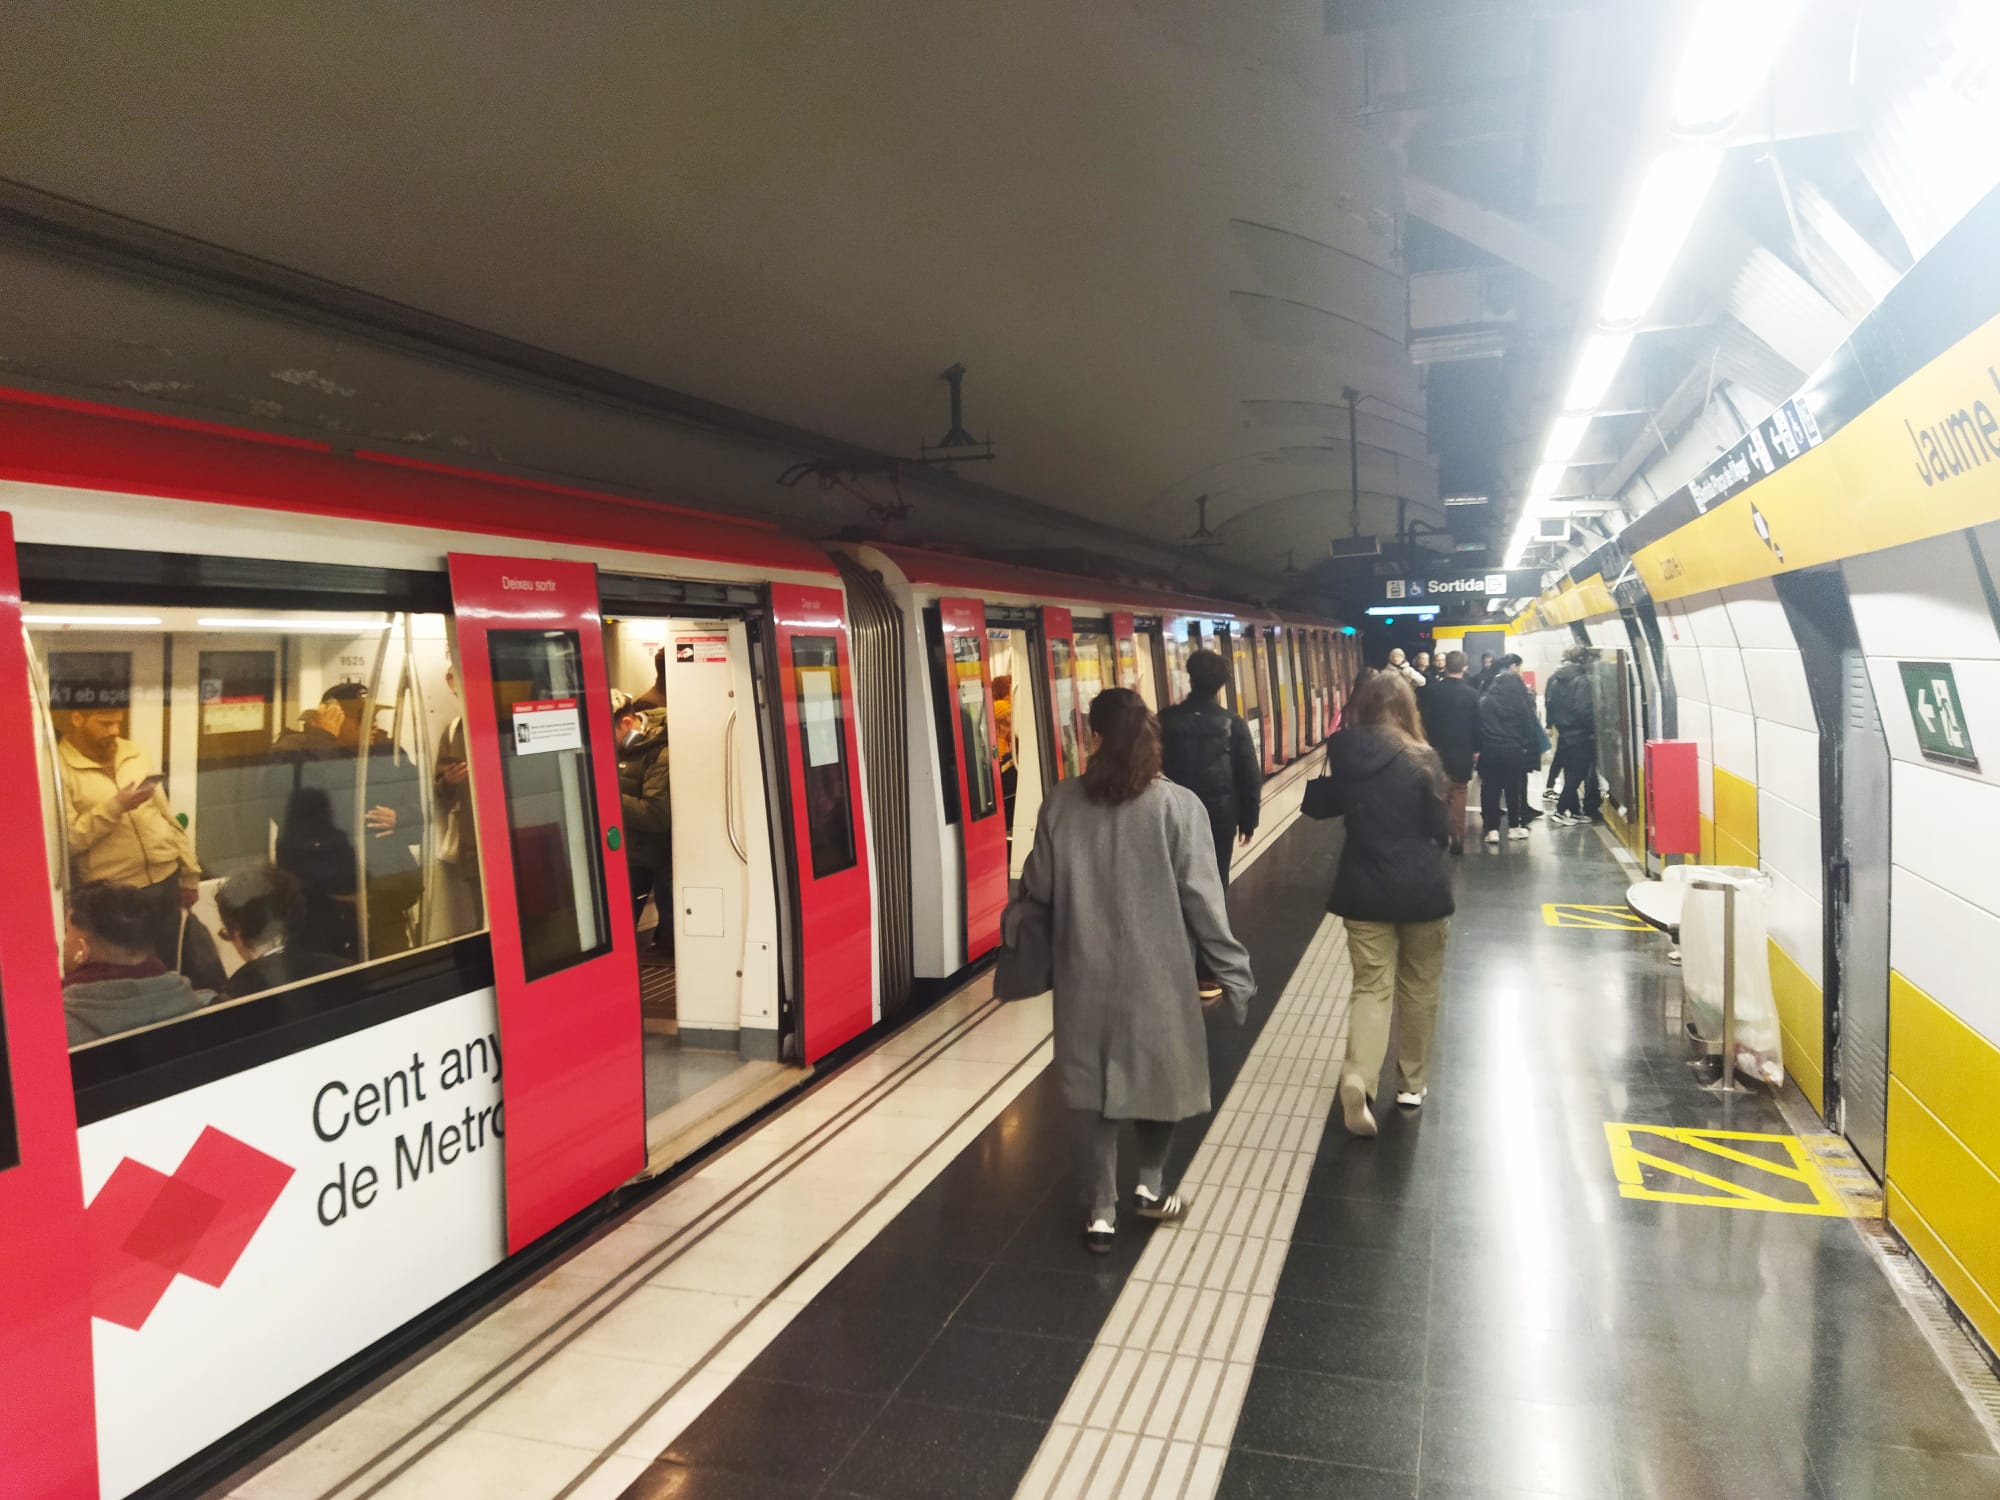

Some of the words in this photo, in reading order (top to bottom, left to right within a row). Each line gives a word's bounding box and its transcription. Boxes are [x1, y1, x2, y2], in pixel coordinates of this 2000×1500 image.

[1904, 400, 2000, 487] Jaume
[502, 576, 533, 590] Deixeu
[1428, 578, 1484, 593] Sortida
[313, 1052, 427, 1142] Cent
[317, 1162, 378, 1227] de
